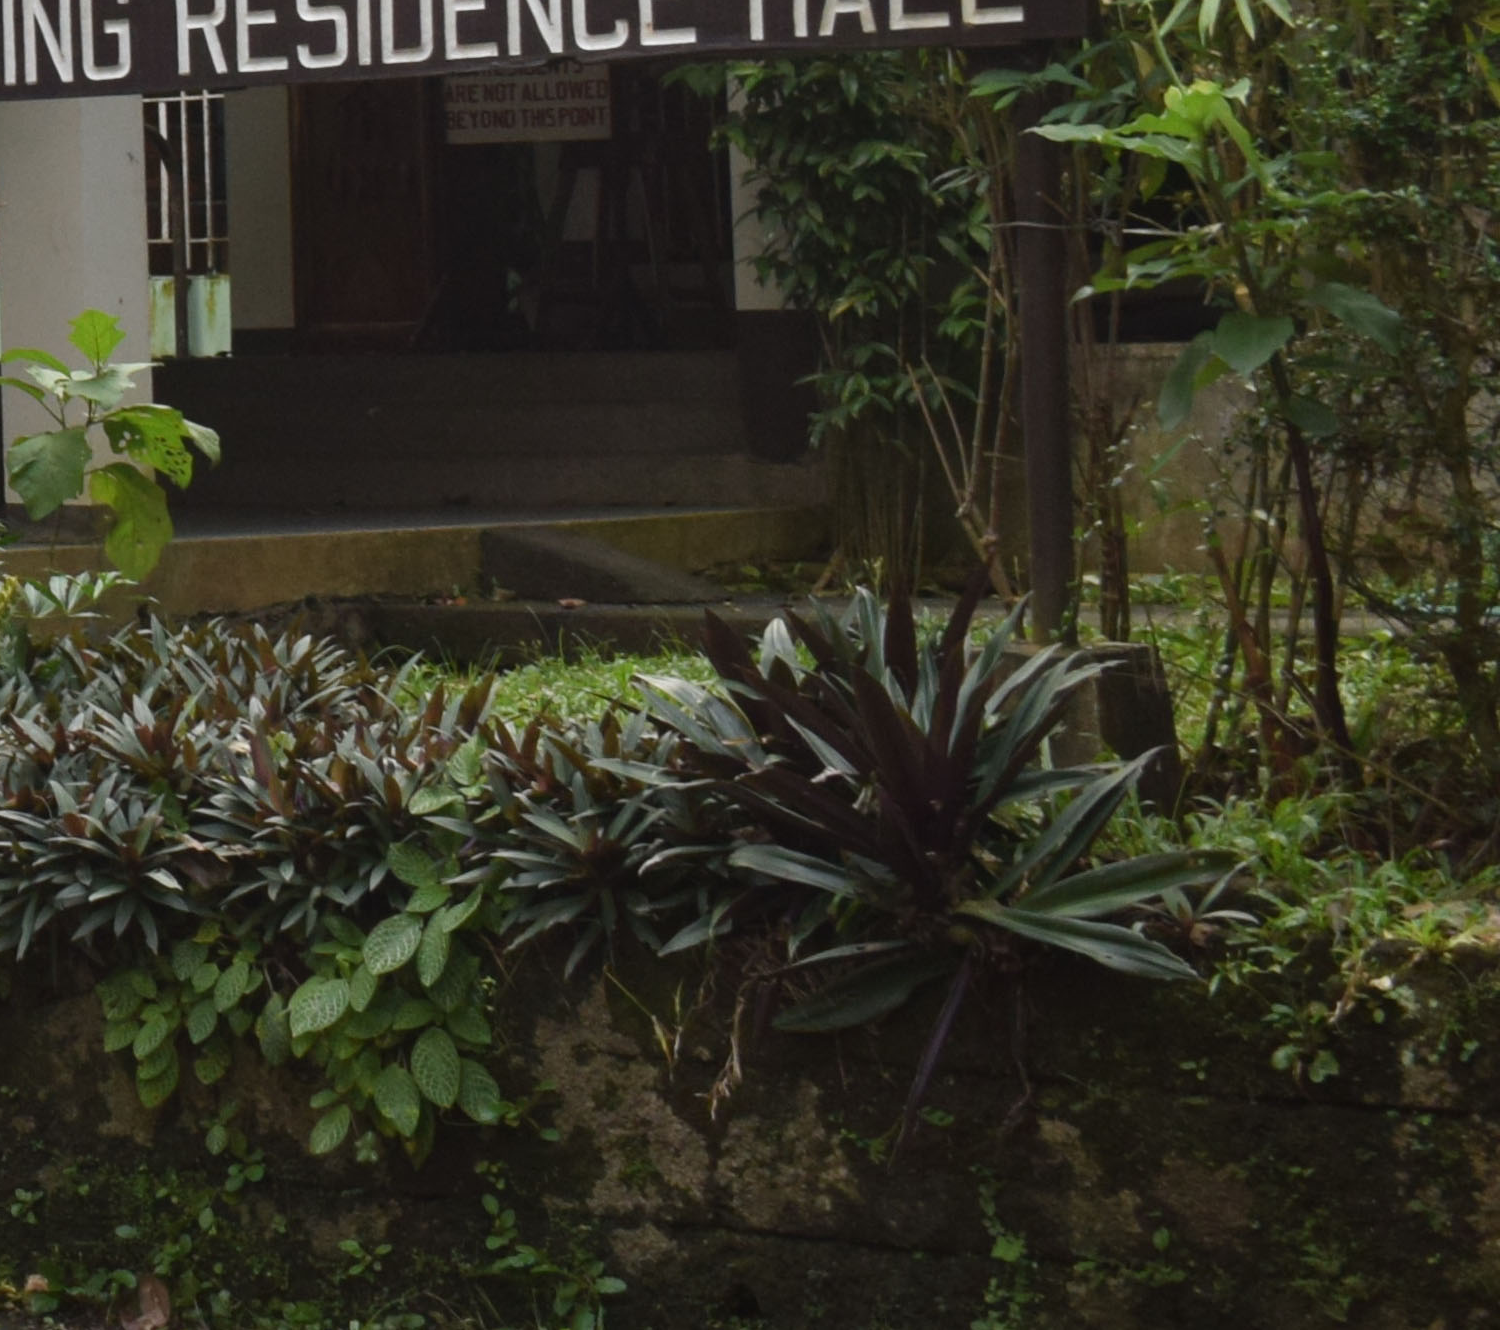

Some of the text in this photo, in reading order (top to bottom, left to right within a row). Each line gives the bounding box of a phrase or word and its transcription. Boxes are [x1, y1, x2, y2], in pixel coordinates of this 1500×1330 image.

[444, 79, 608, 103] ARE NOT ALLOWED
[447, 105, 607, 130] BEYOND THIS POINT
